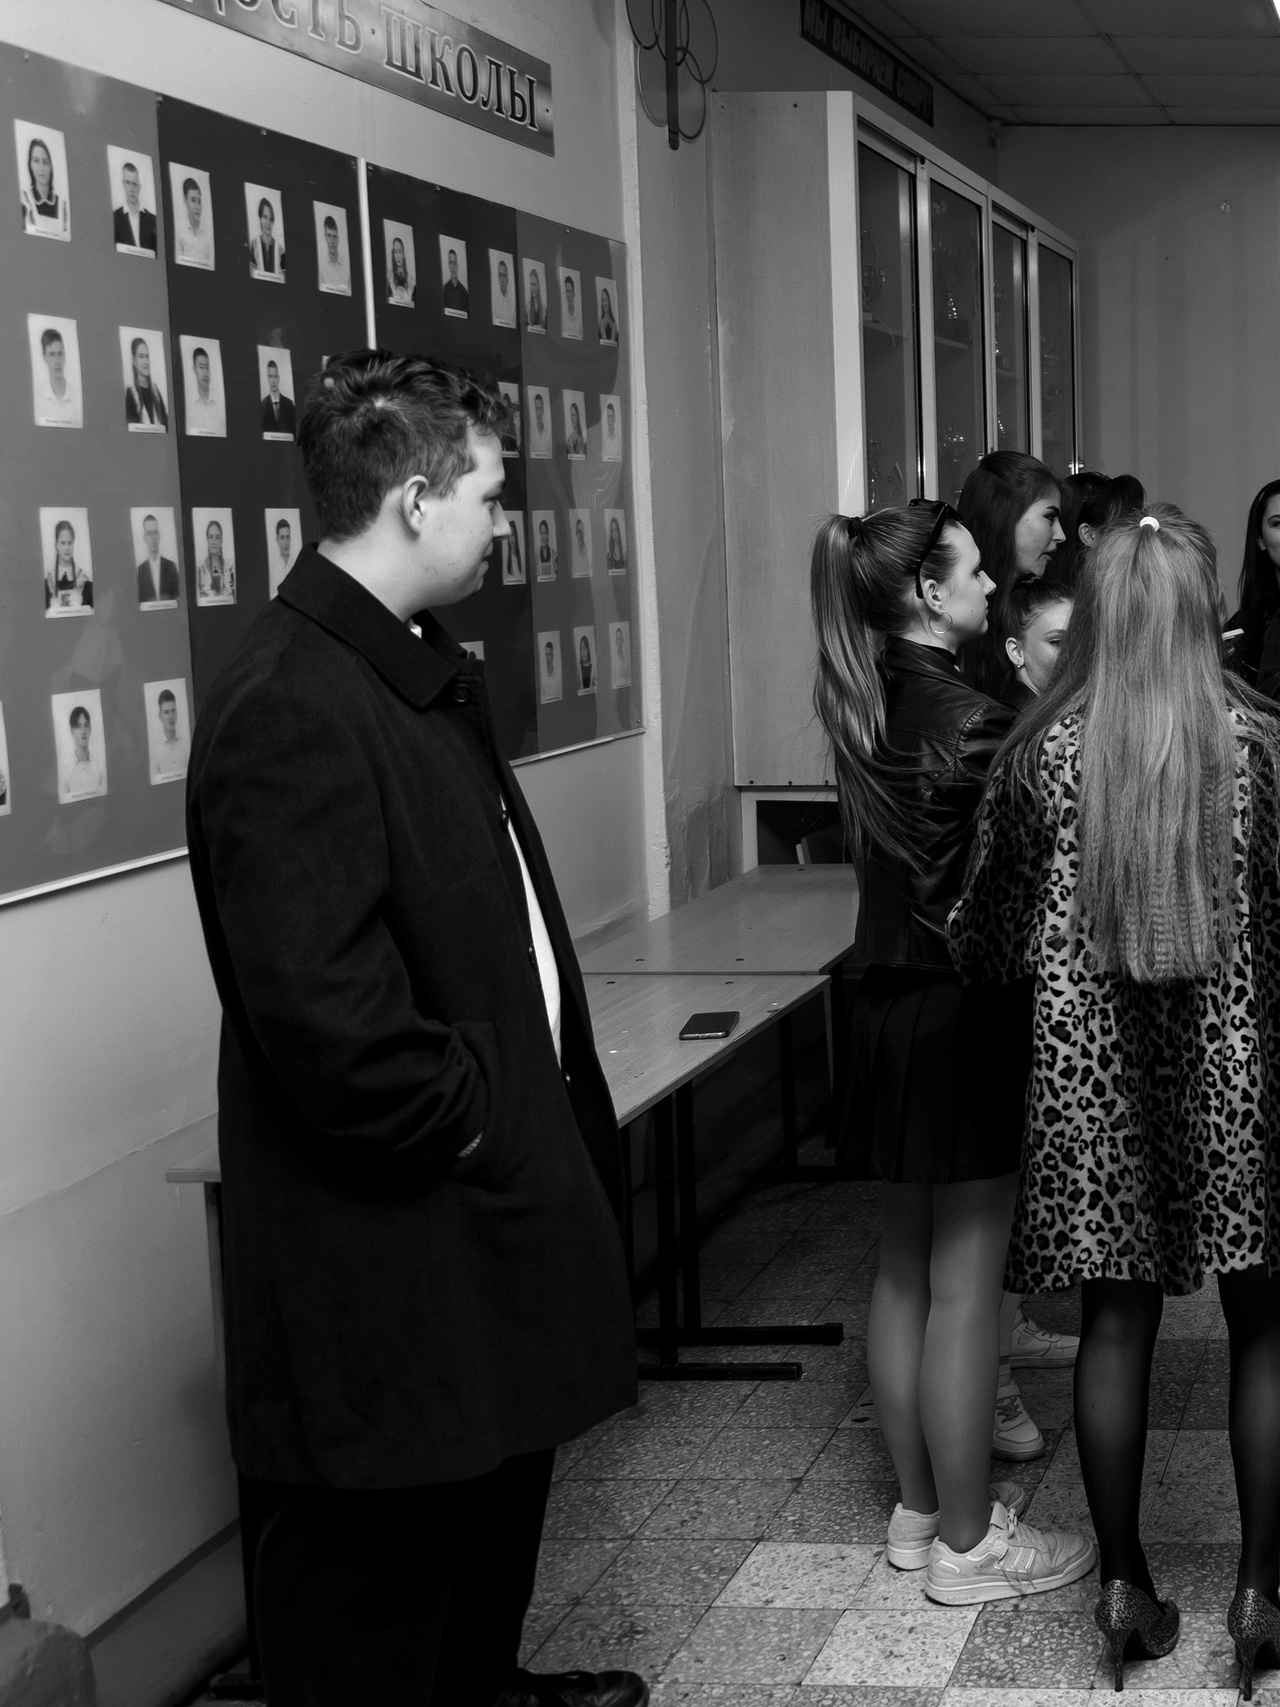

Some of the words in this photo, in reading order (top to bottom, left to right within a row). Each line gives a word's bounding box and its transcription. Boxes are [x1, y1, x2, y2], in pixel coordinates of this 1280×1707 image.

[381, 5, 539, 132] ШКОЛЫ
[804, 0, 828, 43] МЫ
[833, 17, 895, 91] ВЫБИРАЕМ
